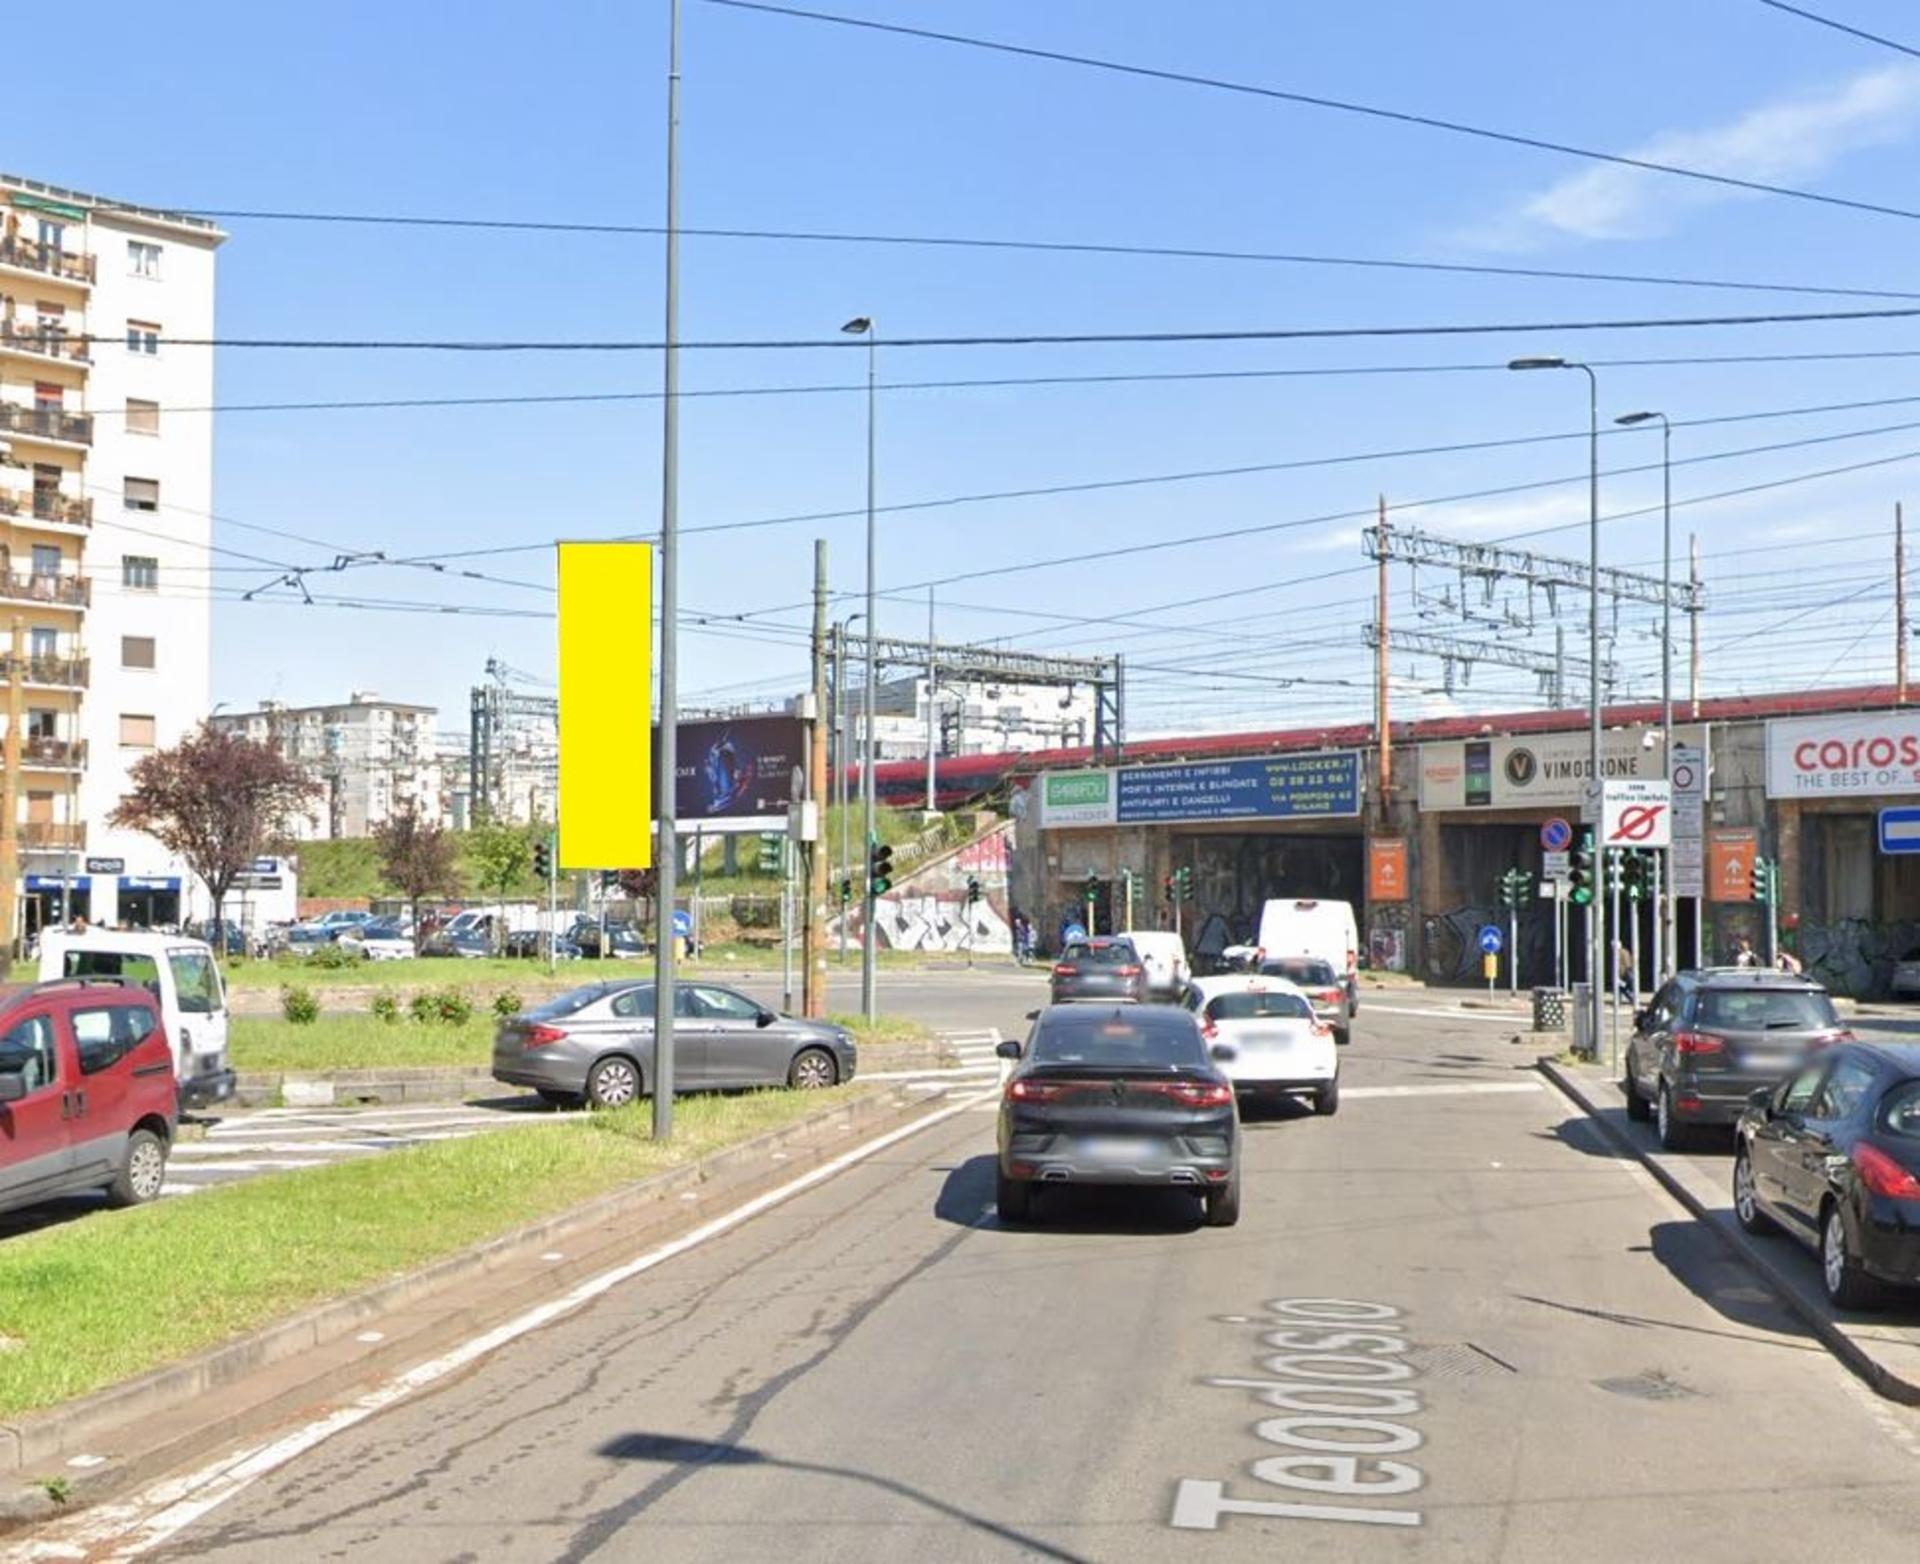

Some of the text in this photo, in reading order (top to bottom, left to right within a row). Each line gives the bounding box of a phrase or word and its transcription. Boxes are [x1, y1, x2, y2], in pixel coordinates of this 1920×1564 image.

[1795, 735, 1919, 771] caros
[1121, 784, 1151, 794] PORTE
[1154, 782, 1196, 793] INTERNE
[1209, 778, 1258, 790] BLINDATE
[1794, 774, 1824, 788] THE
[1830, 772, 1868, 787] BEST
[1121, 797, 1169, 807] ANTIFURTI
[1182, 794, 1231, 806] CANCELLI
[1171, 1298, 1422, 1529] Teodosio
